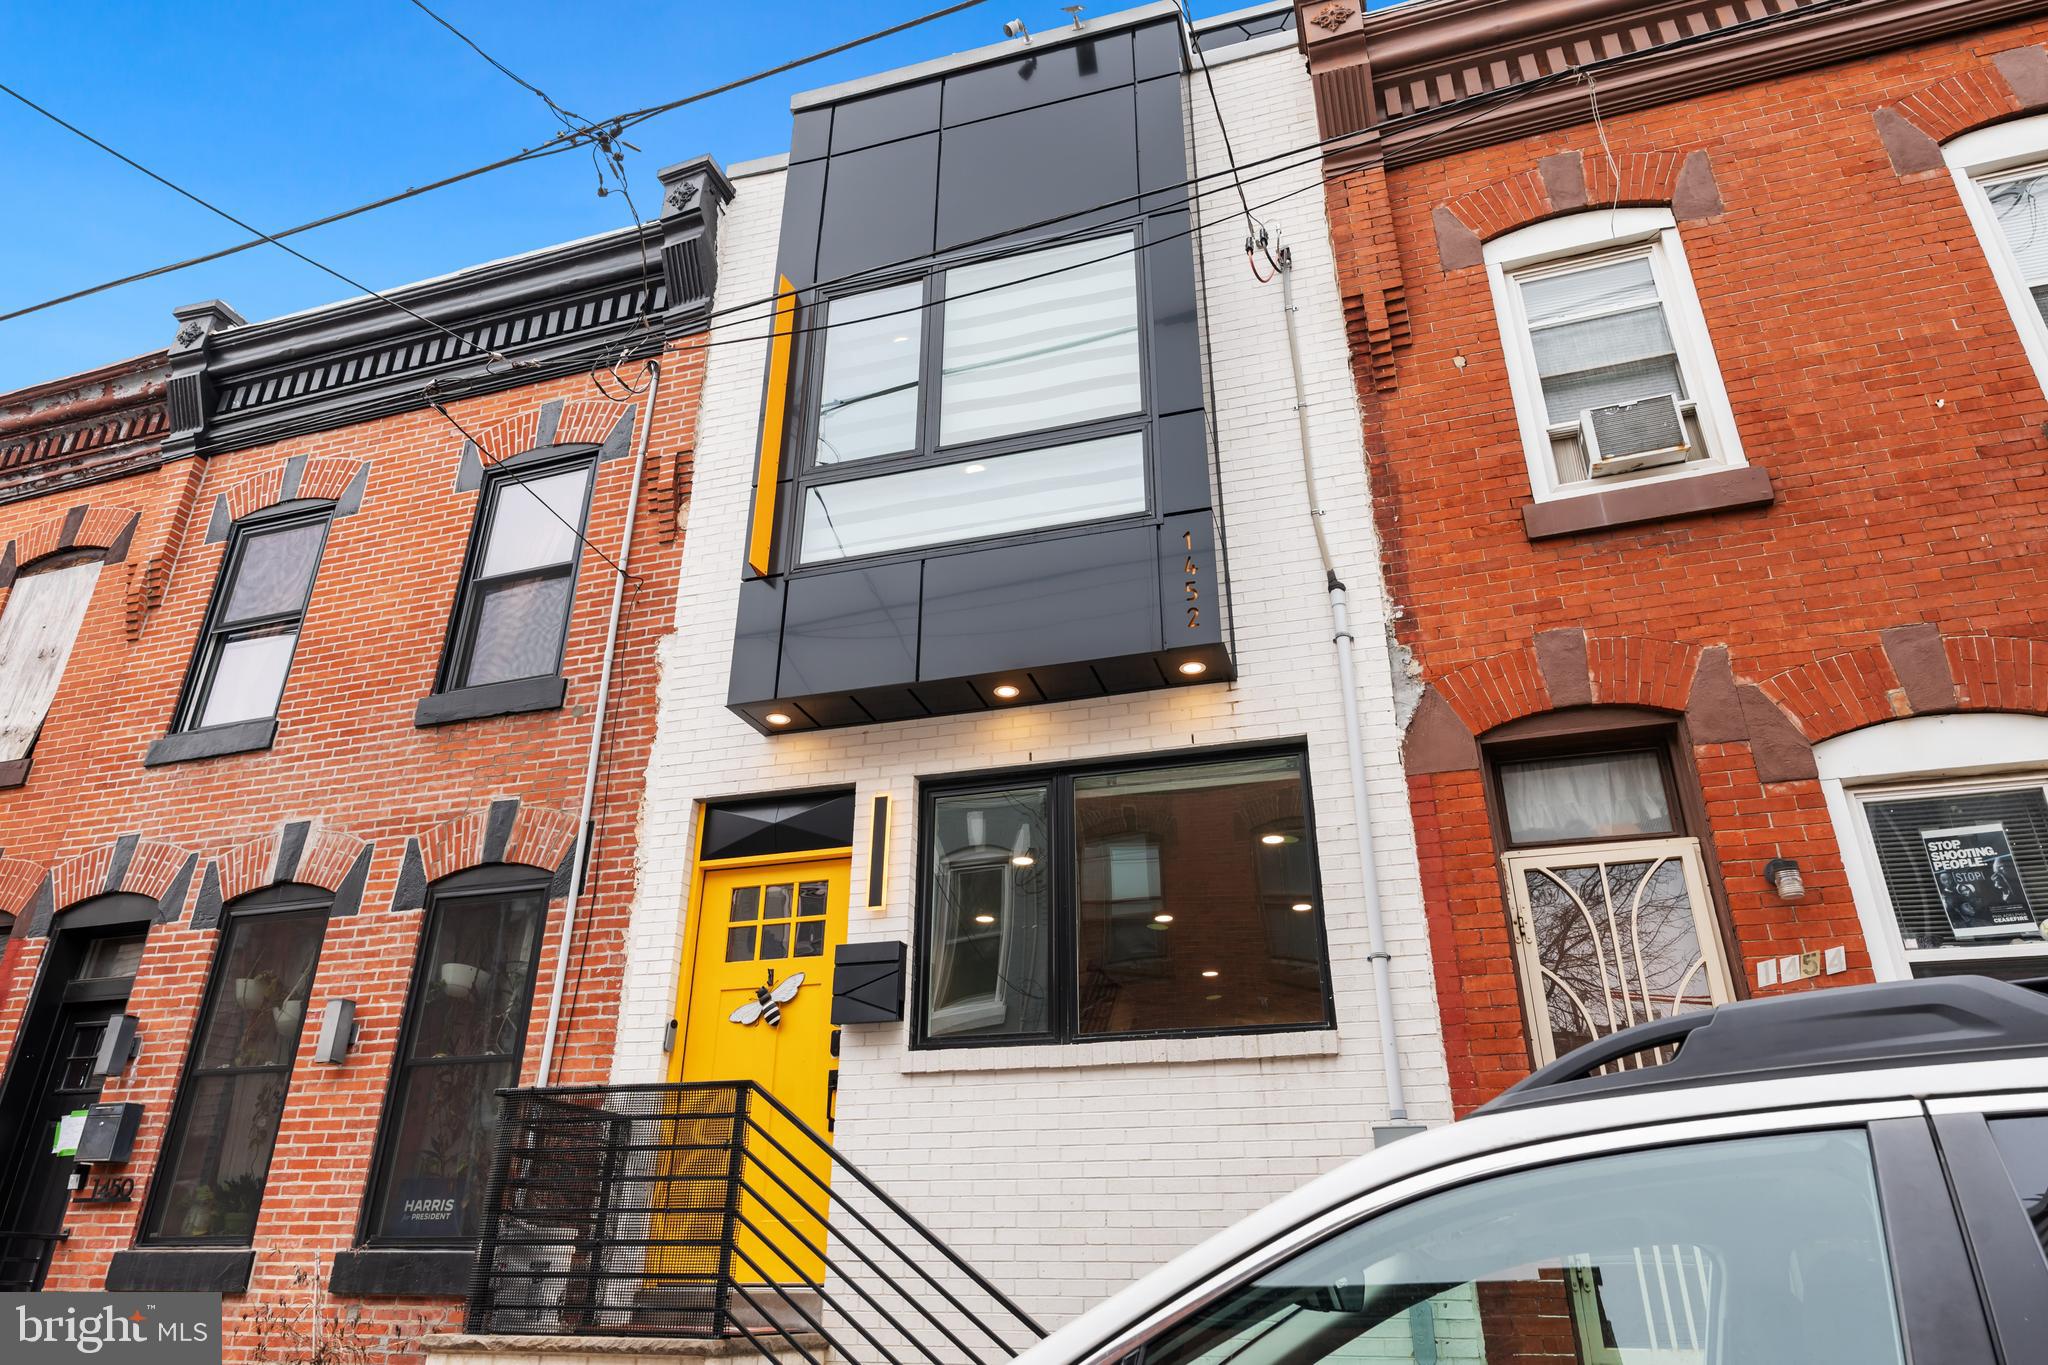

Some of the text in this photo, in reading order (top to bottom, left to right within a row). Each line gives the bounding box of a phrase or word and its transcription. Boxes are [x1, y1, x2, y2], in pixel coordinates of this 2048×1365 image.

[1182, 530, 1200, 628] 1452
[1927, 839, 1961, 851] STOP.
[1930, 846, 1998, 862] SHOOTING.
[1933, 857, 1988, 871] PEOPLE.
[1955, 872, 1983, 883] STOP
[1993, 915, 2029, 923] CEASEFIRE
[92, 1178, 135, 1200] 1450
[404, 1199, 455, 1212] HARRIS
[411, 1212, 452, 1221] PRESIDENT
